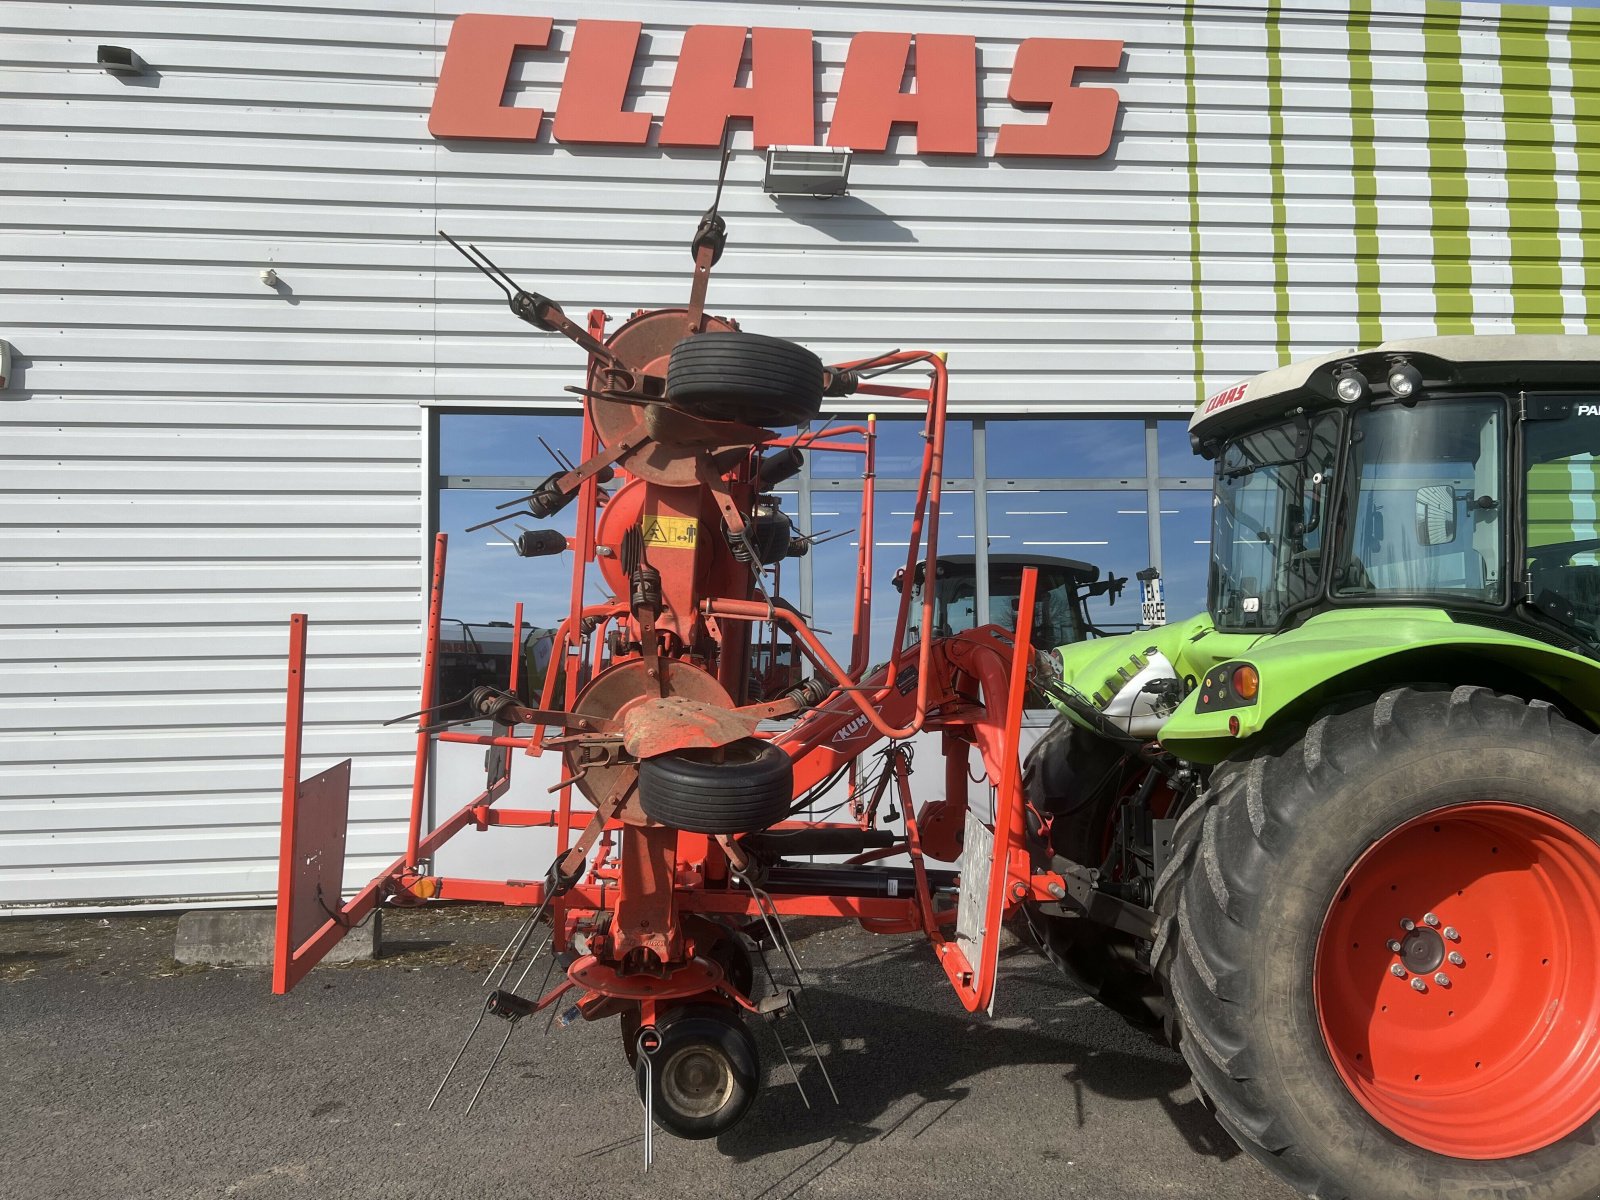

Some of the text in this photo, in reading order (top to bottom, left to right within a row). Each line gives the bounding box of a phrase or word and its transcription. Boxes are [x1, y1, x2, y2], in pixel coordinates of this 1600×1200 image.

[428, 13, 1124, 158] CLAAS
[1205, 384, 1249, 414] CLAAS
[1578, 405, 1600, 416] PA
